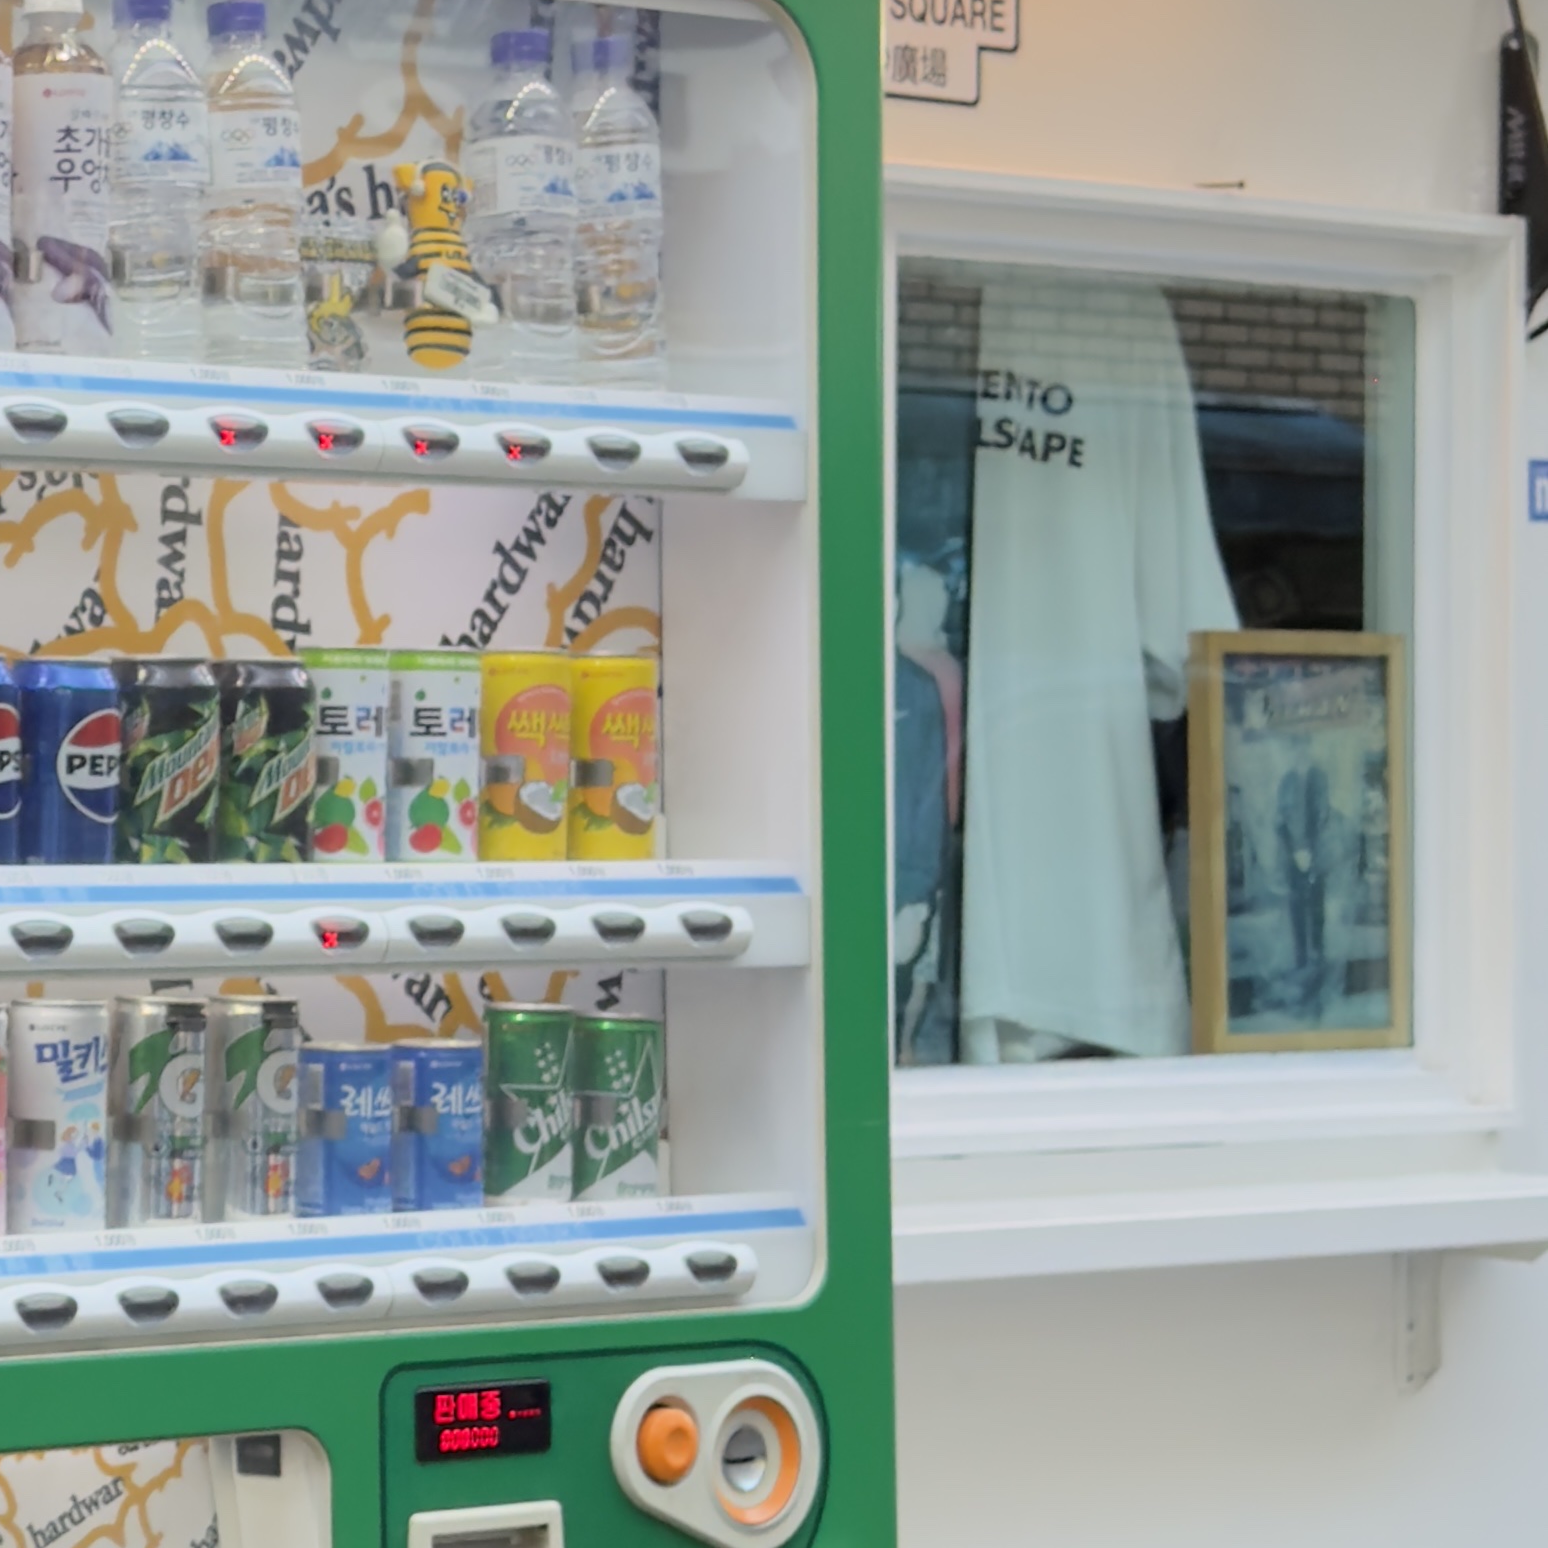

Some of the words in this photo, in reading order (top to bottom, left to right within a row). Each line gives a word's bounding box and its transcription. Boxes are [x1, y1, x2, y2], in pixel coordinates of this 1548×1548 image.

[140, 108, 192, 131] 평창수
[52, 125, 112, 158] 초가
[49, 157, 110, 194] 우엉
[437, 488, 572, 652] hardwa
[65, 752, 121, 777] PEP
[33, 1036, 108, 1084] 밀키
[434, 1389, 501, 1425] 판매중
